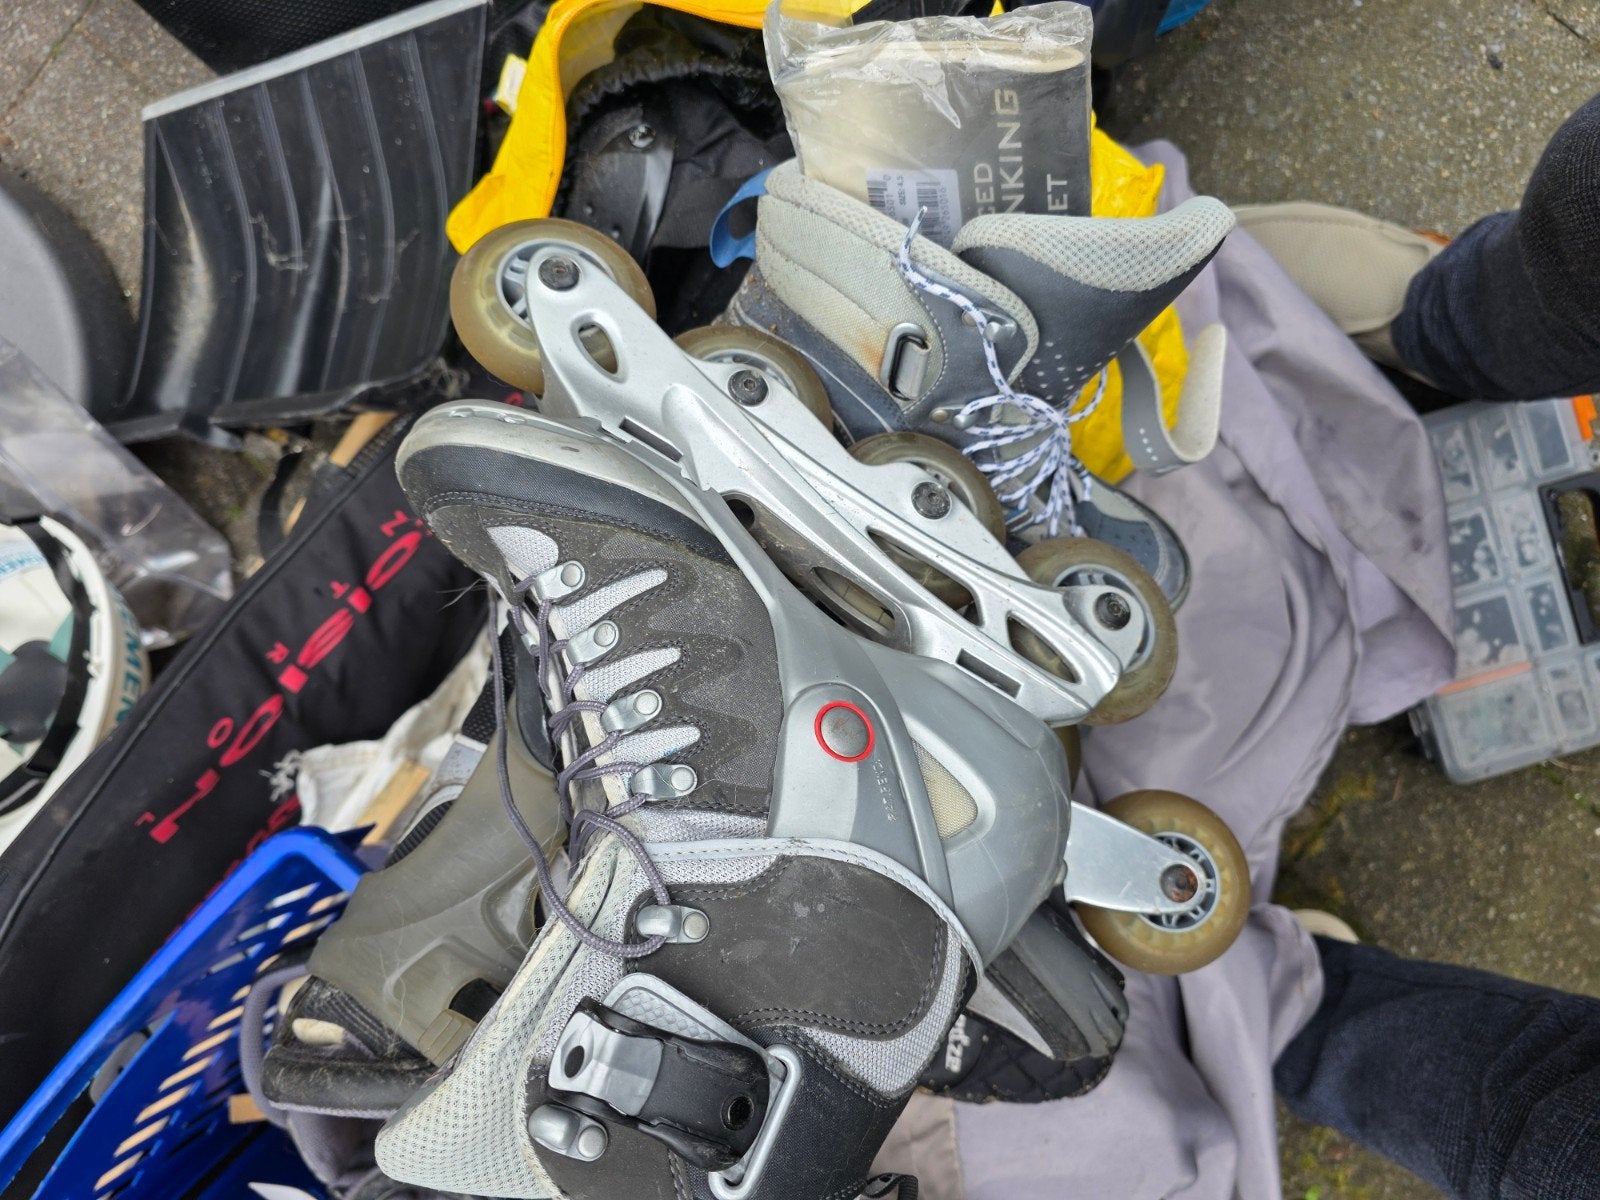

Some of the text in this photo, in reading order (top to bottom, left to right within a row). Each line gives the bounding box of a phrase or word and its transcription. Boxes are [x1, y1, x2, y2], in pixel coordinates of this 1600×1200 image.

[995, 88, 1025, 215] NKING
[1046, 173, 1068, 213] ET
[150, 519, 431, 844] CISION
